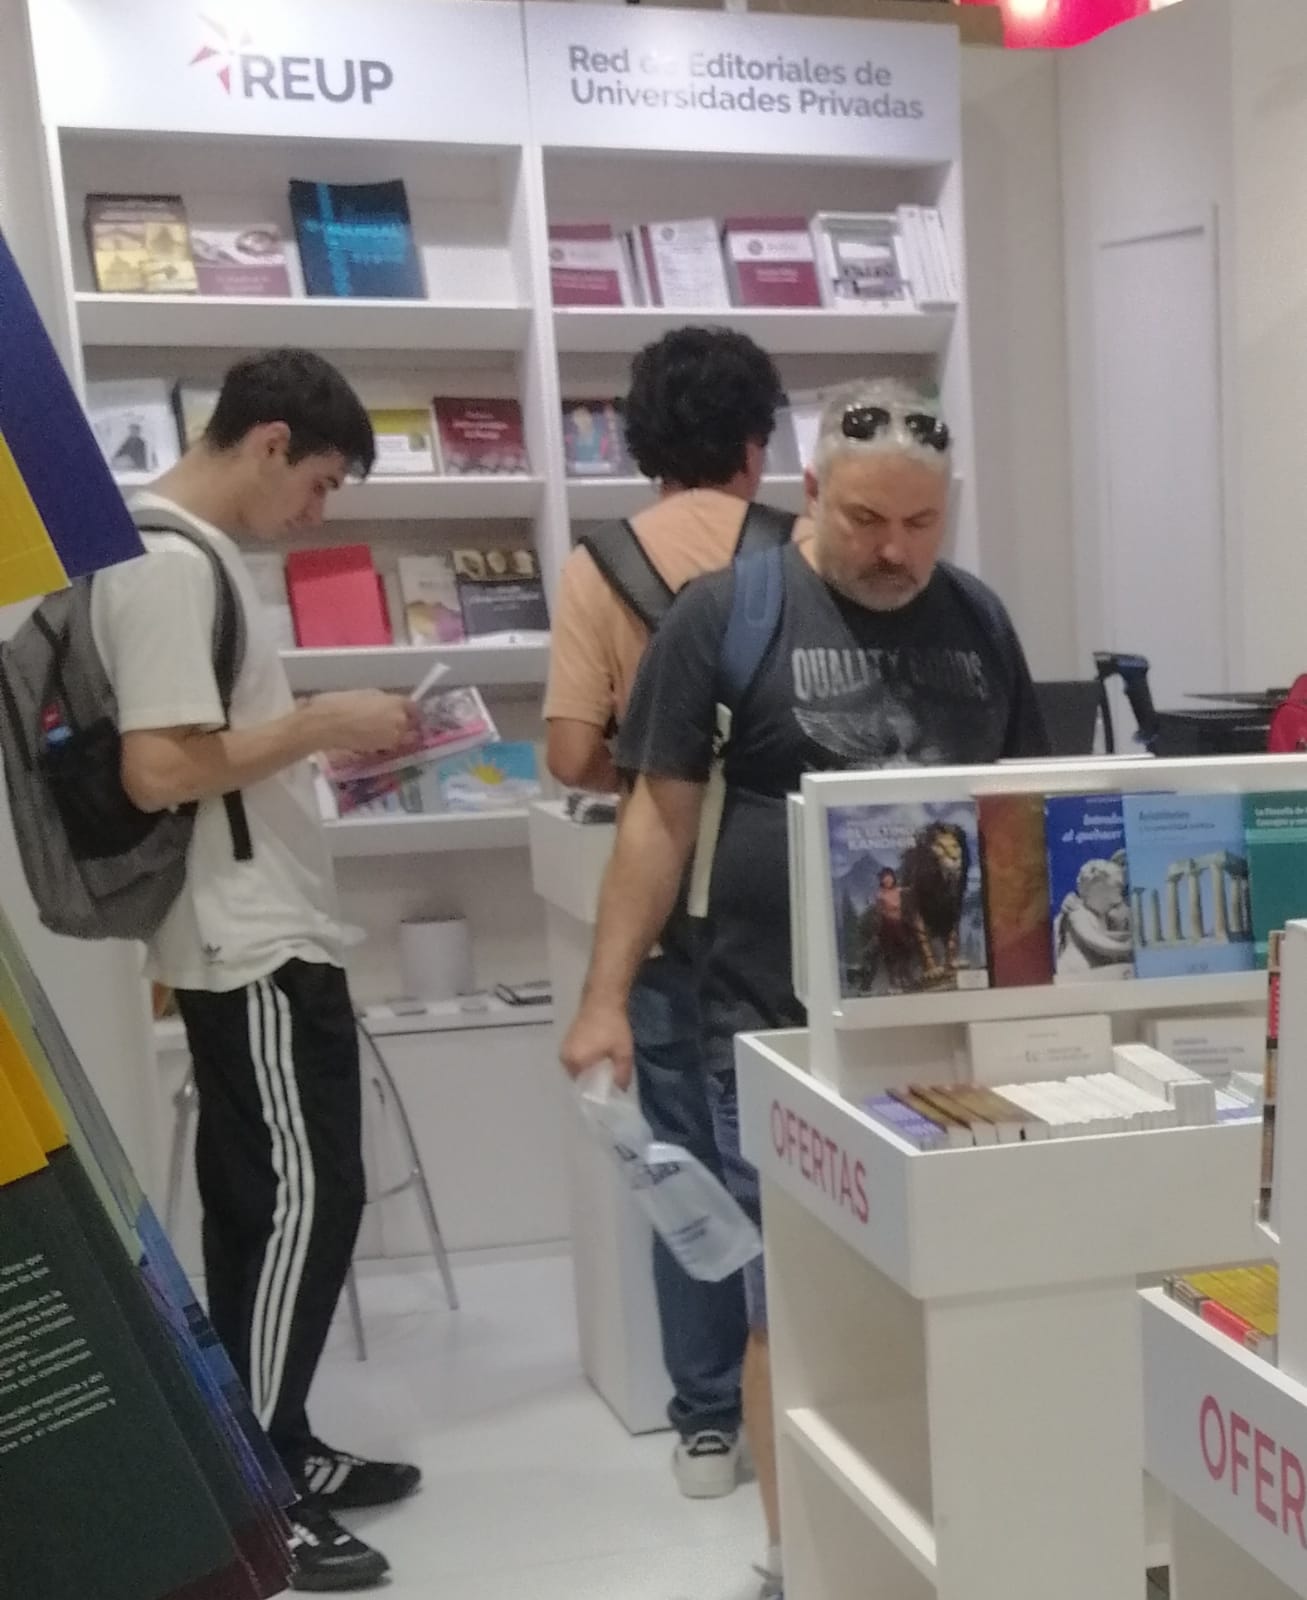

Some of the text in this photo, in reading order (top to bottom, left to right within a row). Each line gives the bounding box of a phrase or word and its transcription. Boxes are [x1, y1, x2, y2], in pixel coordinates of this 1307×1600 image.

[239, 53, 394, 104] REUP
[569, 45, 630, 73] Red
[690, 52, 847, 85] Editoriales
[855, 60, 892, 86] de
[571, 78, 923, 120] Universidades Privadas
[771, 1099, 868, 1224] OFERTAS
[1198, 1394, 1307, 1550] OFER
